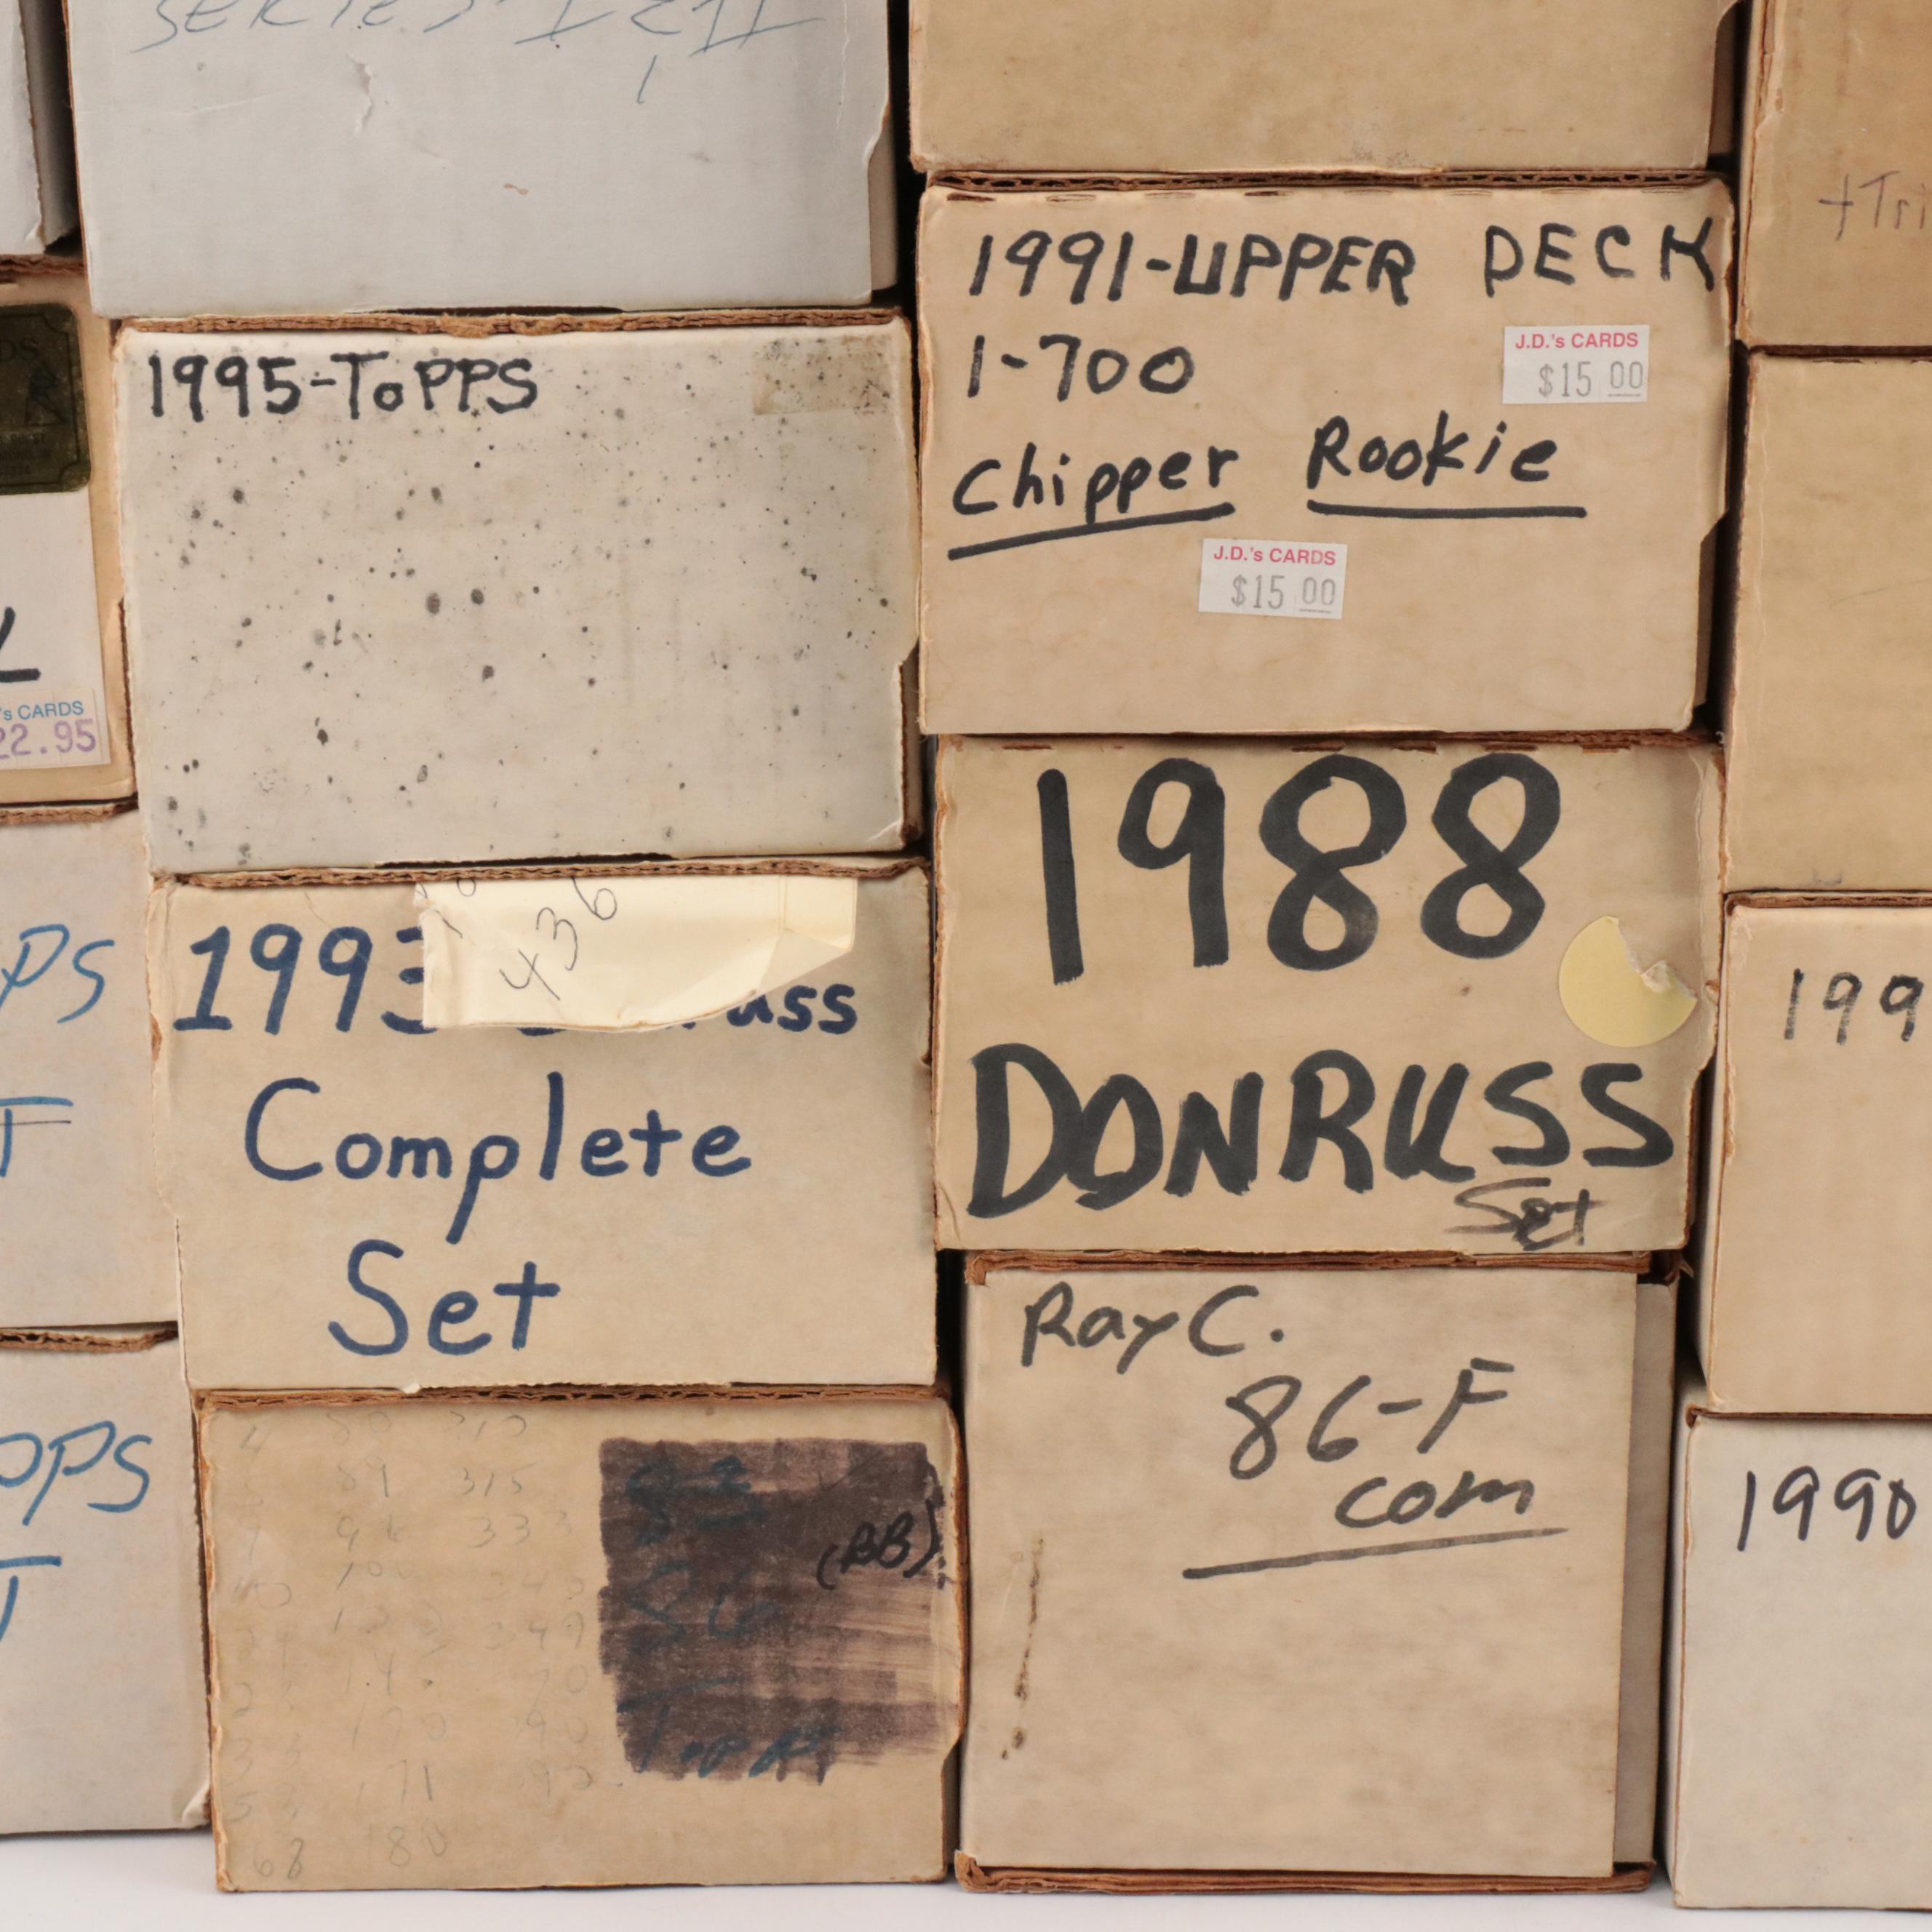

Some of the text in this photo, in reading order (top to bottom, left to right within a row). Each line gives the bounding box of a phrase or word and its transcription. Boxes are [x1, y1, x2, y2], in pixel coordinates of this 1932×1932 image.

[1485, 217, 1715, 298] DECK
[968, 334, 1194, 402] 1-700
[1515, 332, 1639, 349] J.D.'s CARDS
[1306, 410, 1557, 490] Rookie
[1213, 546, 1336, 566] J.D.'s CARDS
[1037, 753, 1560, 985] 1988
[245, 1071, 752, 1245] Complete
[967, 1043, 1674, 1218] DONRUSS
[328, 1240, 561, 1356] Set
[1021, 1282, 1180, 1374] Ray
[1737, 1465, 1917, 1552] 1990
